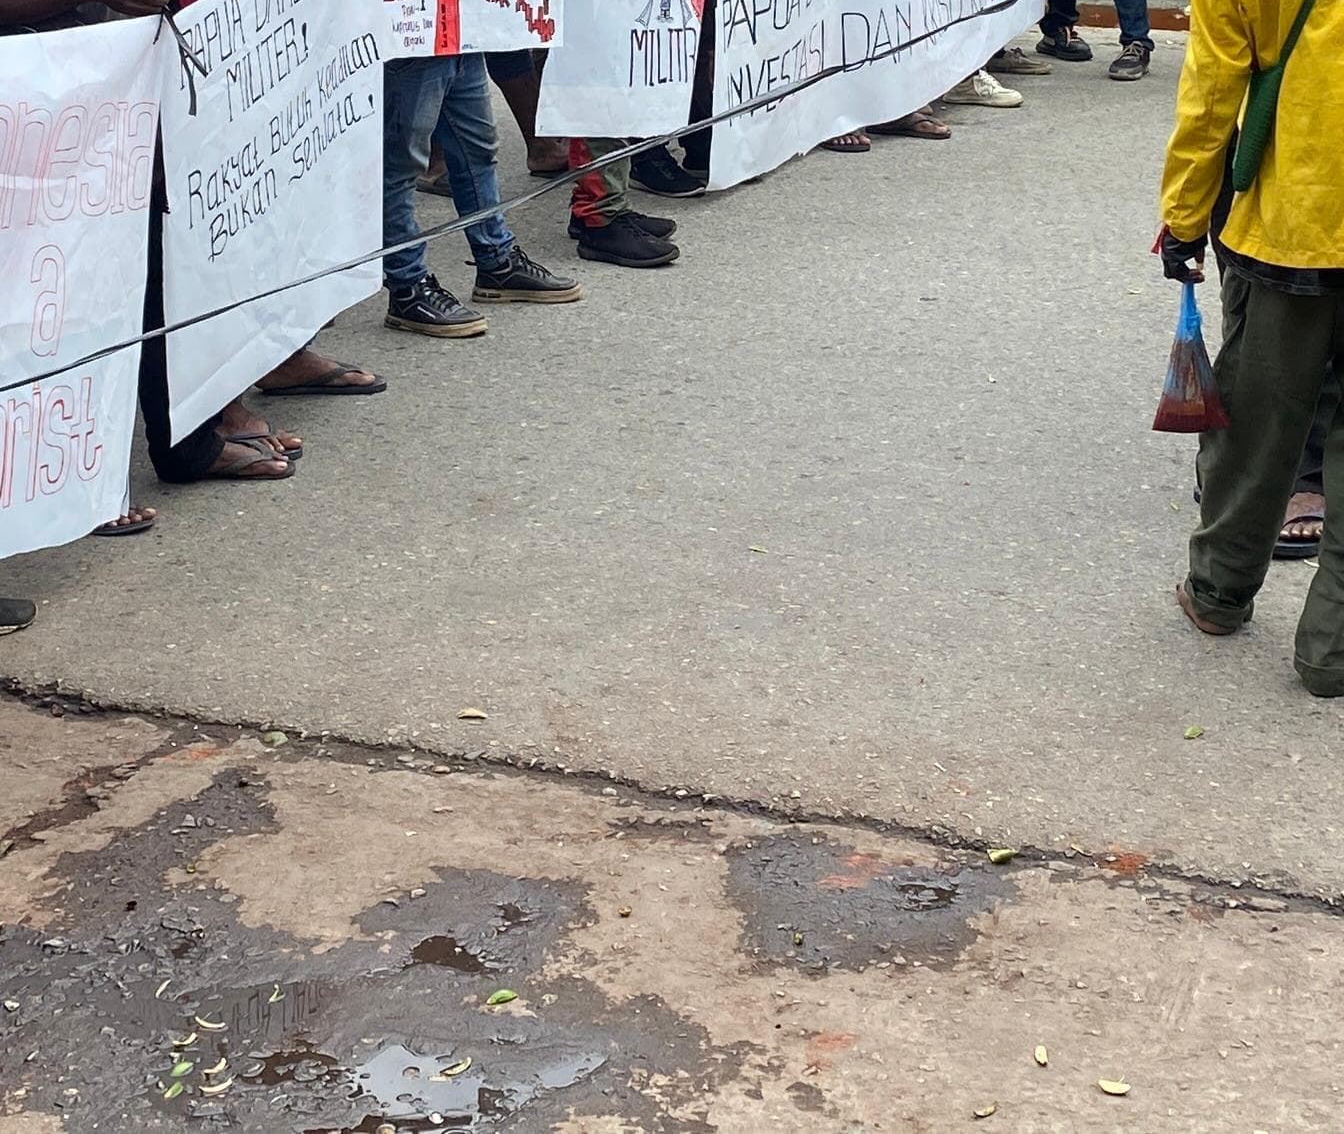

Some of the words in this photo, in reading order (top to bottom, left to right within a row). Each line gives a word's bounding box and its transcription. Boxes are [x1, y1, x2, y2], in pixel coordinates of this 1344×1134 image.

[225, 16, 309, 122] MILITER!
[727, 19, 825, 128] INVESTASI
[841, 2, 913, 73] DAN
[31, 244, 66, 358] a
